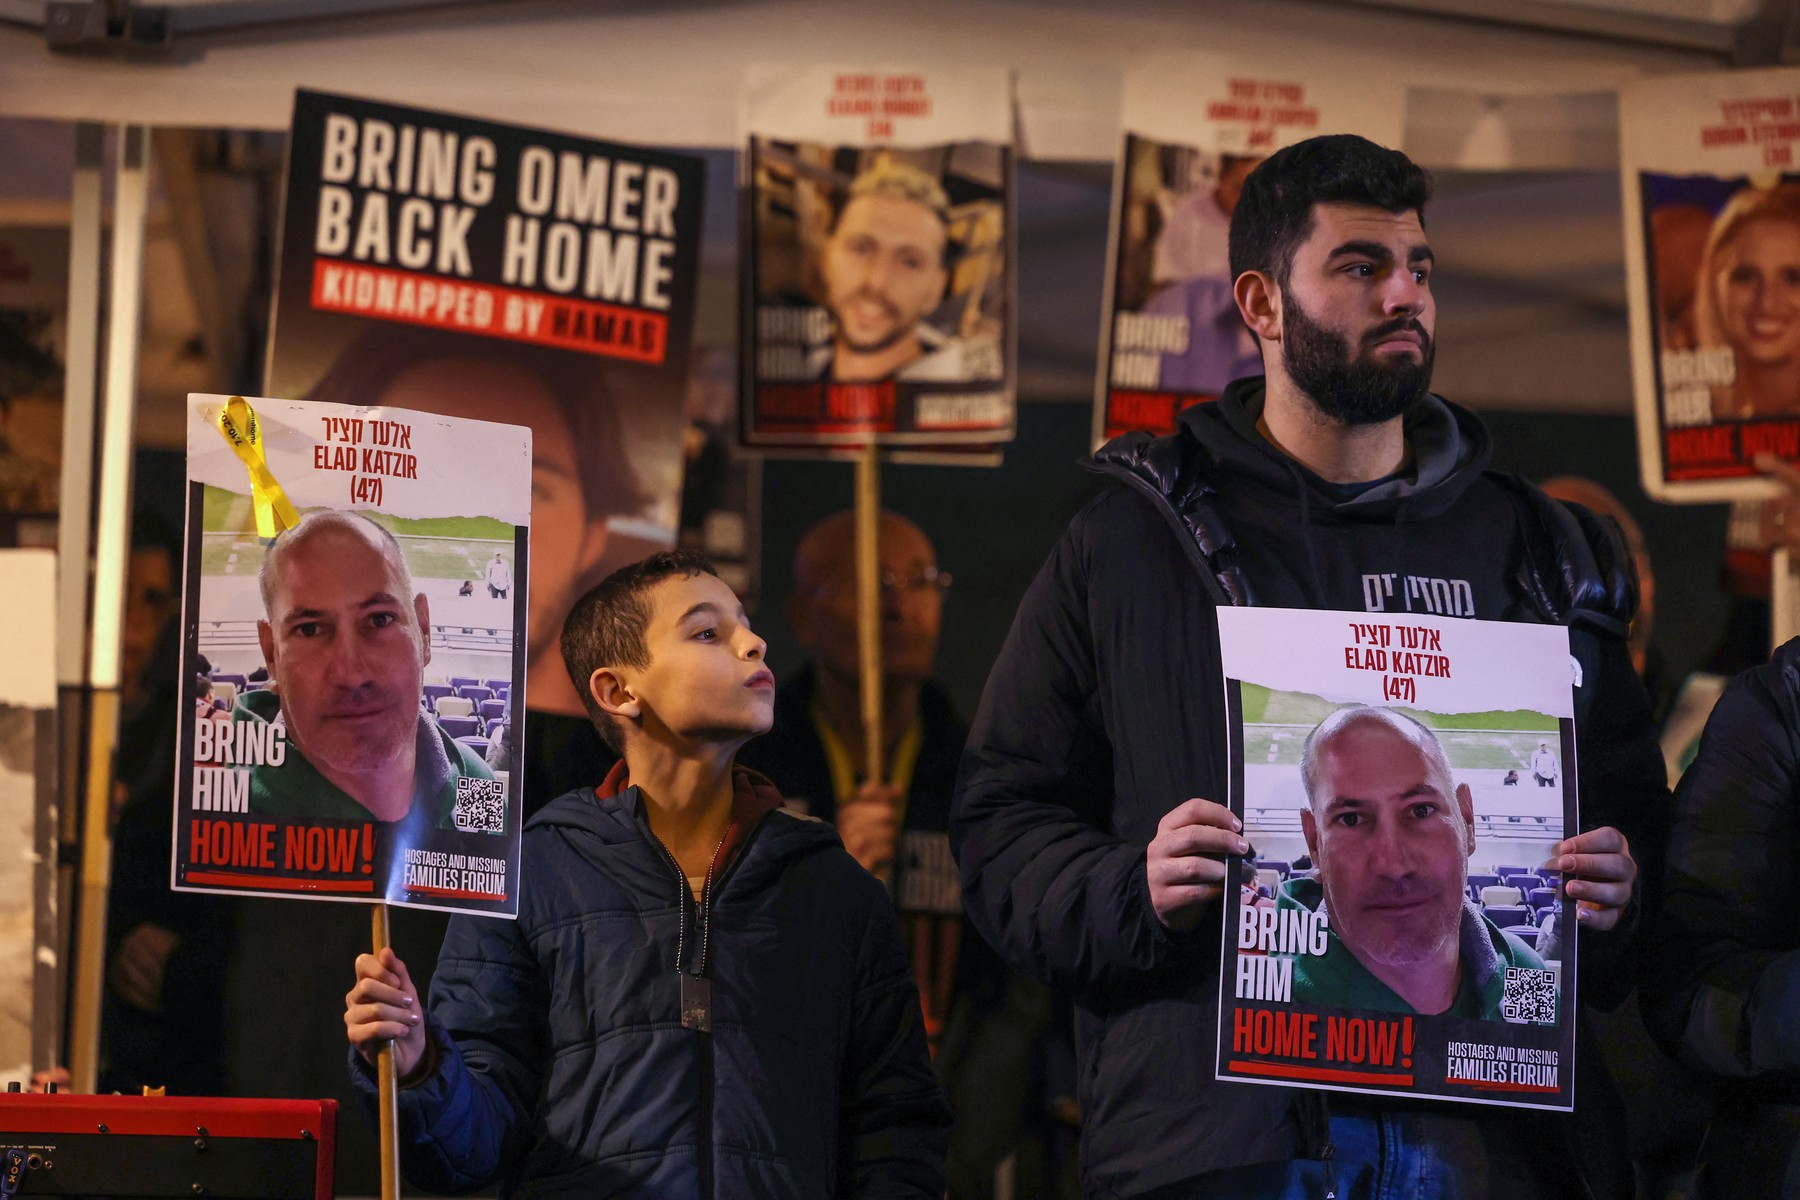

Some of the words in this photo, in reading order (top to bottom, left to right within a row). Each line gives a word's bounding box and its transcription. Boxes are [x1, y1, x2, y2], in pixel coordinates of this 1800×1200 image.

[322, 113, 497, 206] BRING
[517, 145, 680, 237] OMER
[315, 185, 477, 277] BACK
[502, 213, 676, 310] HOME
[321, 266, 494, 328] KIDNAPPED
[503, 296, 546, 336] BY
[551, 306, 657, 354] HAMAS
[321, 417, 364, 446] קציר
[368, 420, 412, 450] אלעד
[314, 445, 357, 472] ELAD
[362, 448, 418, 480] KATZIR
[350, 475, 383, 507] (47)
[1348, 623, 1391, 649] קציר
[1396, 625, 1442, 652] אלעד
[1344, 647, 1388, 672] ELAD
[1392, 650, 1452, 679] KATZIR
[1383, 674, 1416, 704] (47)
[193, 717, 287, 768] BRING
[191, 766, 251, 814] HIM
[189, 819, 277, 869] HOME
[284, 823, 374, 875] NOW!
[404, 848, 447, 868] HOSTAGES
[448, 853, 466, 870] AND
[467, 855, 506, 875] MISSING
[404, 863, 459, 891] FAMILIES
[461, 870, 506, 896] FORUM
[1237, 904, 1329, 957] BRING
[1235, 953, 1293, 1003] HIM
[1233, 1007, 1319, 1060] HOME
[1326, 1015, 1413, 1069] NOW!
[1447, 1041, 1495, 1060] HOSTAGES
[1496, 1046, 1515, 1062] AND
[1517, 1047, 1558, 1066] MISSING
[1447, 1057, 1508, 1083] FAMILIES
[1510, 1062, 1558, 1088] FORUM
[8, 1157, 22, 1183] VOX
